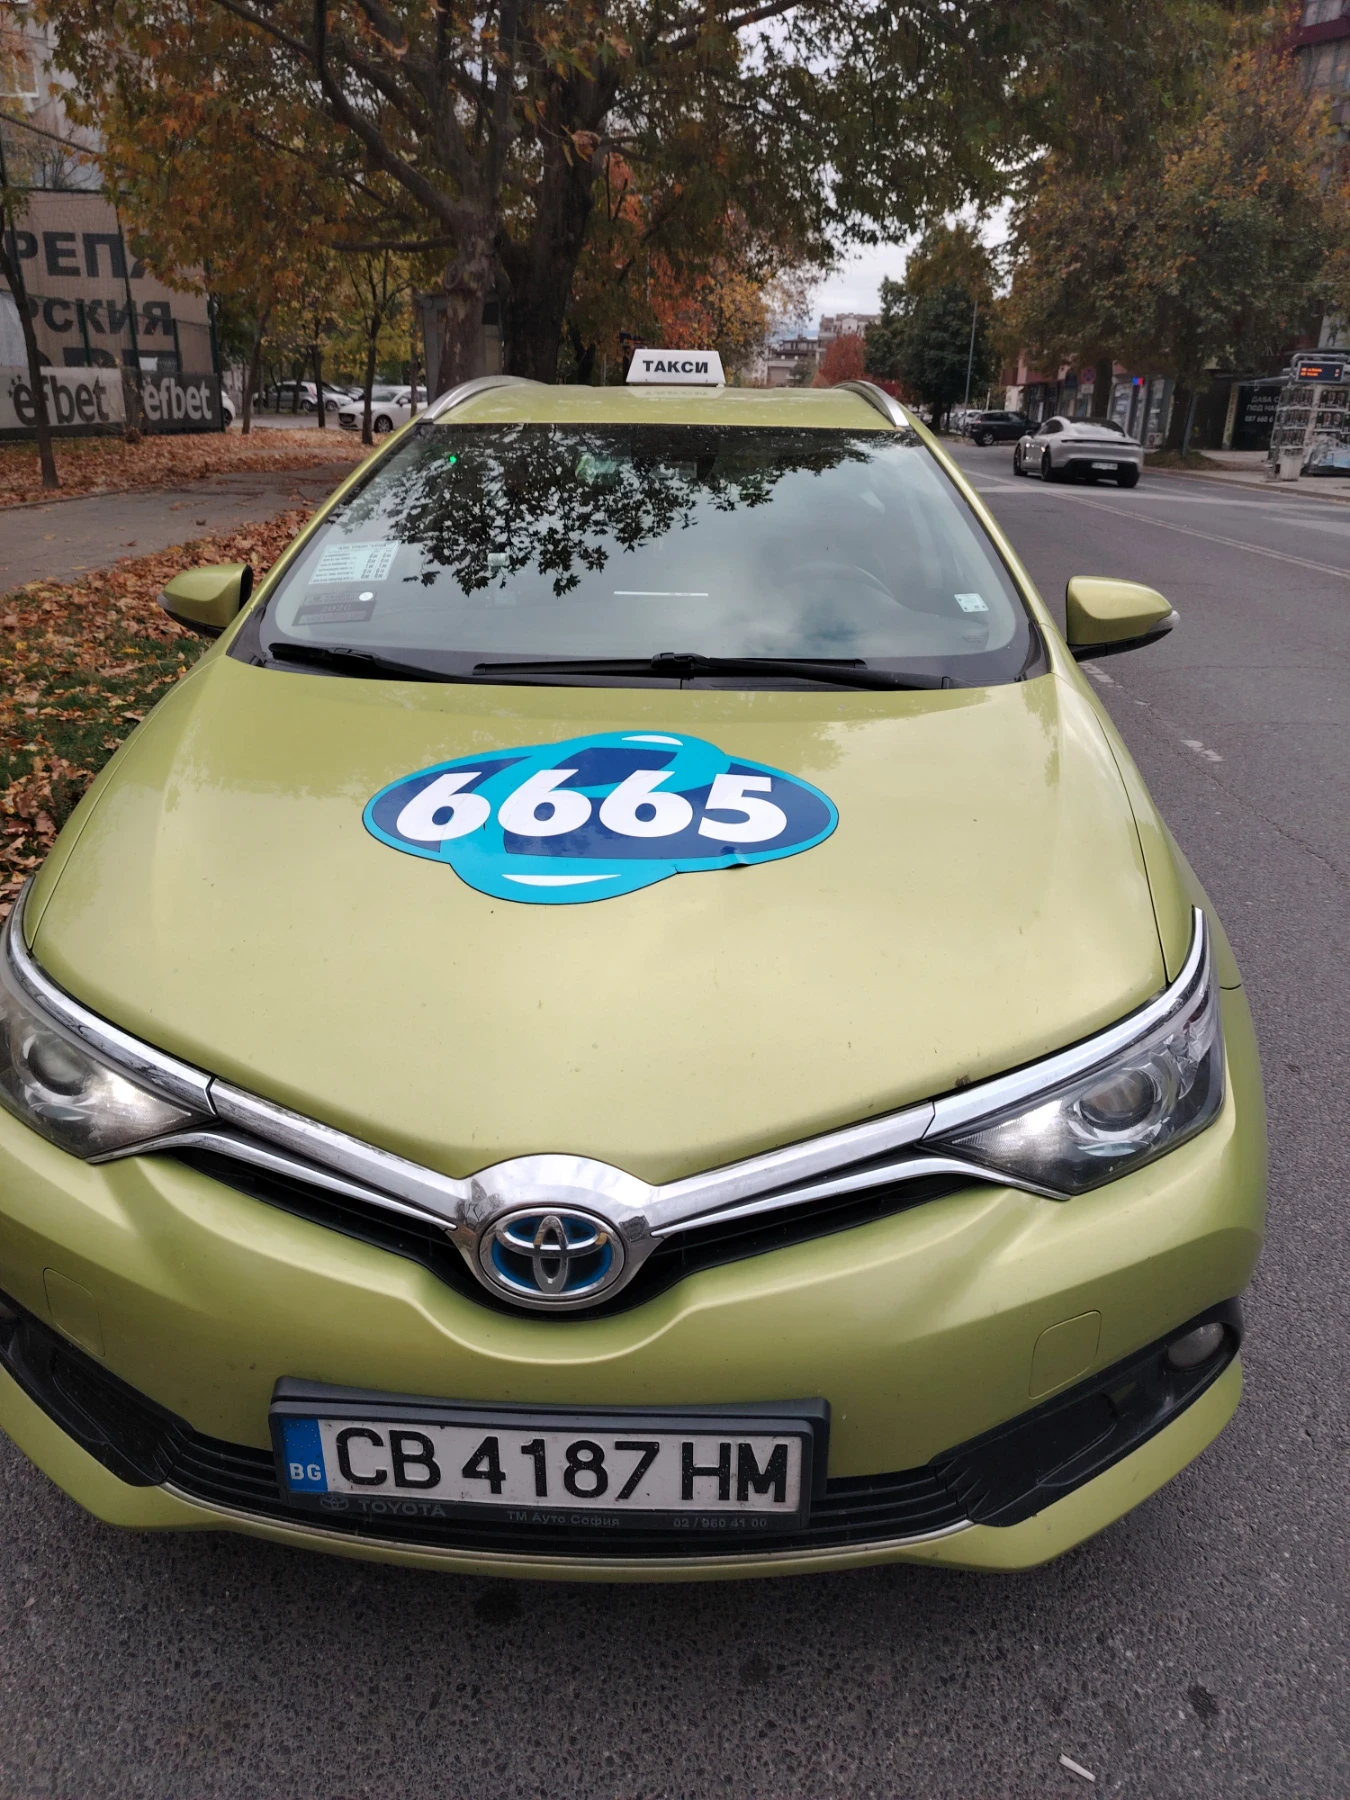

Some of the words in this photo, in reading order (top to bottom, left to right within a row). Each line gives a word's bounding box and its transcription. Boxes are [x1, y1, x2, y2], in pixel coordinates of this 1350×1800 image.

[642, 360, 709, 374] ТАКСИ
[143, 377, 213, 421] efbet
[396, 769, 787, 843] 6665
[289, 1462, 322, 1482] BG
[336, 1427, 441, 1489] CB
[461, 1436, 661, 1501] 4187
[681, 1441, 788, 1504] HM
[357, 1500, 448, 1517] TOYOTA
[532, 1512, 566, 1526] Ауто
[570, 1514, 620, 1528] София
[673, 1518, 690, 1529] 02
[730, 1518, 747, 1529] 41
[751, 1518, 767, 1529] 00
